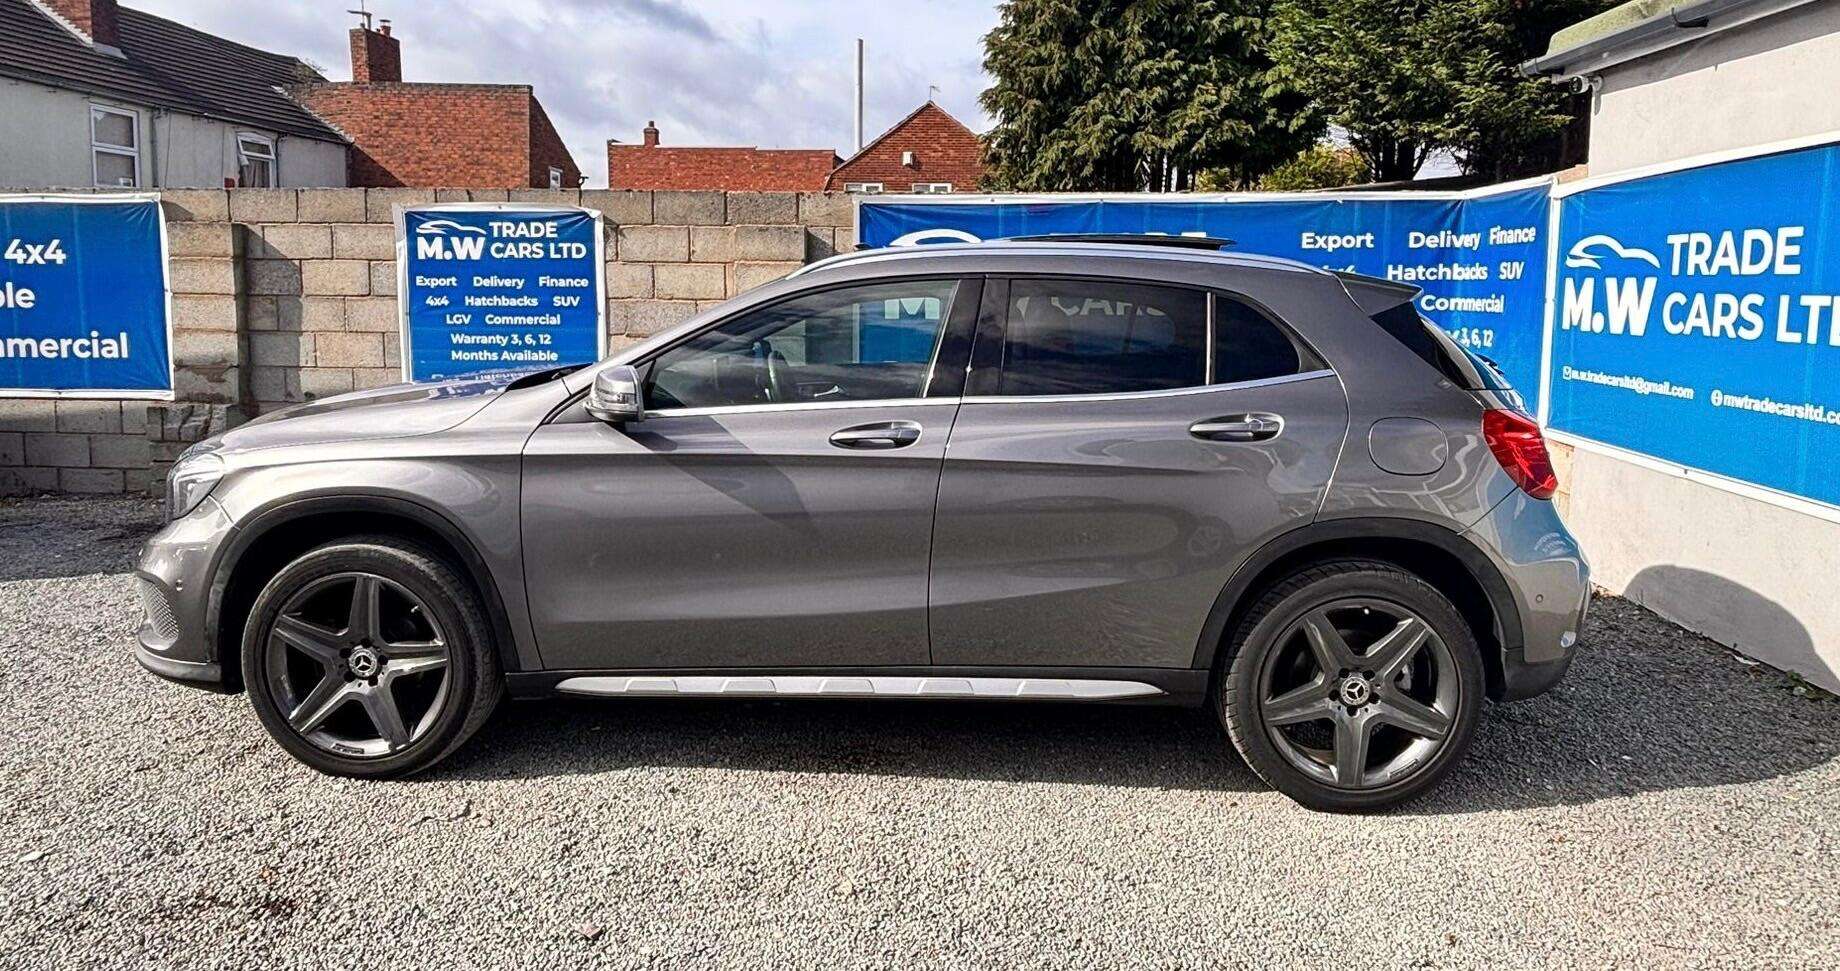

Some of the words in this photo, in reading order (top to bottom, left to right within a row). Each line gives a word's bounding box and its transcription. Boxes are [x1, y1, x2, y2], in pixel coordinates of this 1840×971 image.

[489, 222, 558, 238] TRADE
[1301, 232, 1375, 252] Export
[1408, 231, 1481, 250] Delivery
[1490, 225, 1536, 245] Finance
[4, 238, 67, 265] 4x4
[416, 236, 486, 260] M.W
[490, 243, 544, 259] CARS
[550, 243, 587, 259] LTD
[1666, 226, 1804, 276] TRADE
[1387, 264, 1488, 280] Hatchbacks
[1499, 262, 1525, 280] SUV
[416, 276, 457, 288] Export
[473, 276, 525, 289] Delivery
[539, 276, 589, 287] Finance
[426, 296, 450, 306] 4x4
[464, 296, 539, 306] Hatchbacks
[553, 296, 580, 306] SUV
[1421, 294, 1505, 313] Commercial
[1562, 277, 1658, 337] M.W
[1662, 292, 1765, 341] CARS
[446, 315, 472, 325] LGV
[485, 315, 561, 325] Commercial
[0, 331, 129, 359] mercial
[451, 334, 509, 346] Warranty
[511, 334, 522, 345] 3,
[524, 334, 536, 345] 6,
[539, 334, 552, 345] 12
[1471, 328, 1481, 348] 6,
[1483, 329, 1494, 347] 12
[451, 351, 498, 361] Months
[501, 351, 558, 361] Available
